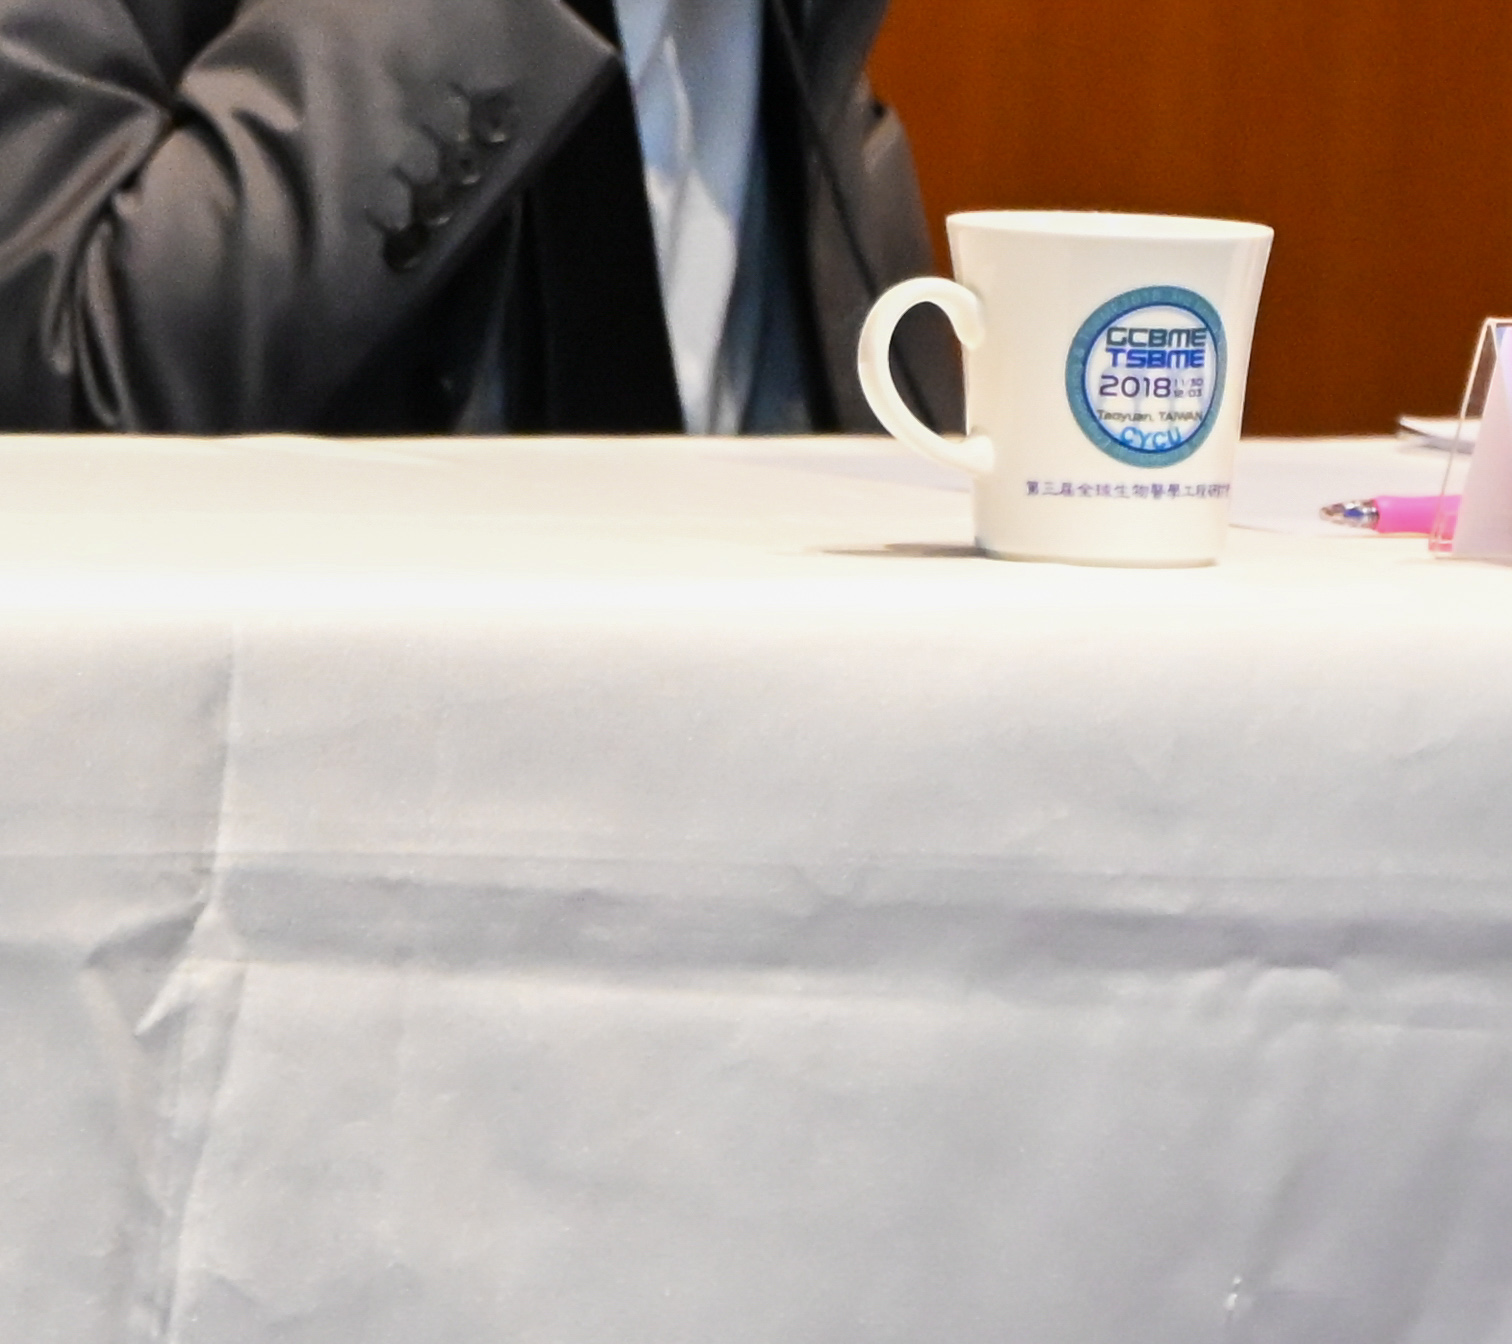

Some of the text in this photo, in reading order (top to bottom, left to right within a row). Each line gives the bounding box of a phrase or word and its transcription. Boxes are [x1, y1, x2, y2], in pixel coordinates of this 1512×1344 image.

[1105, 327, 1208, 348] GCBME
[1105, 348, 1206, 369] TSBME
[1099, 375, 1172, 398] 2018
